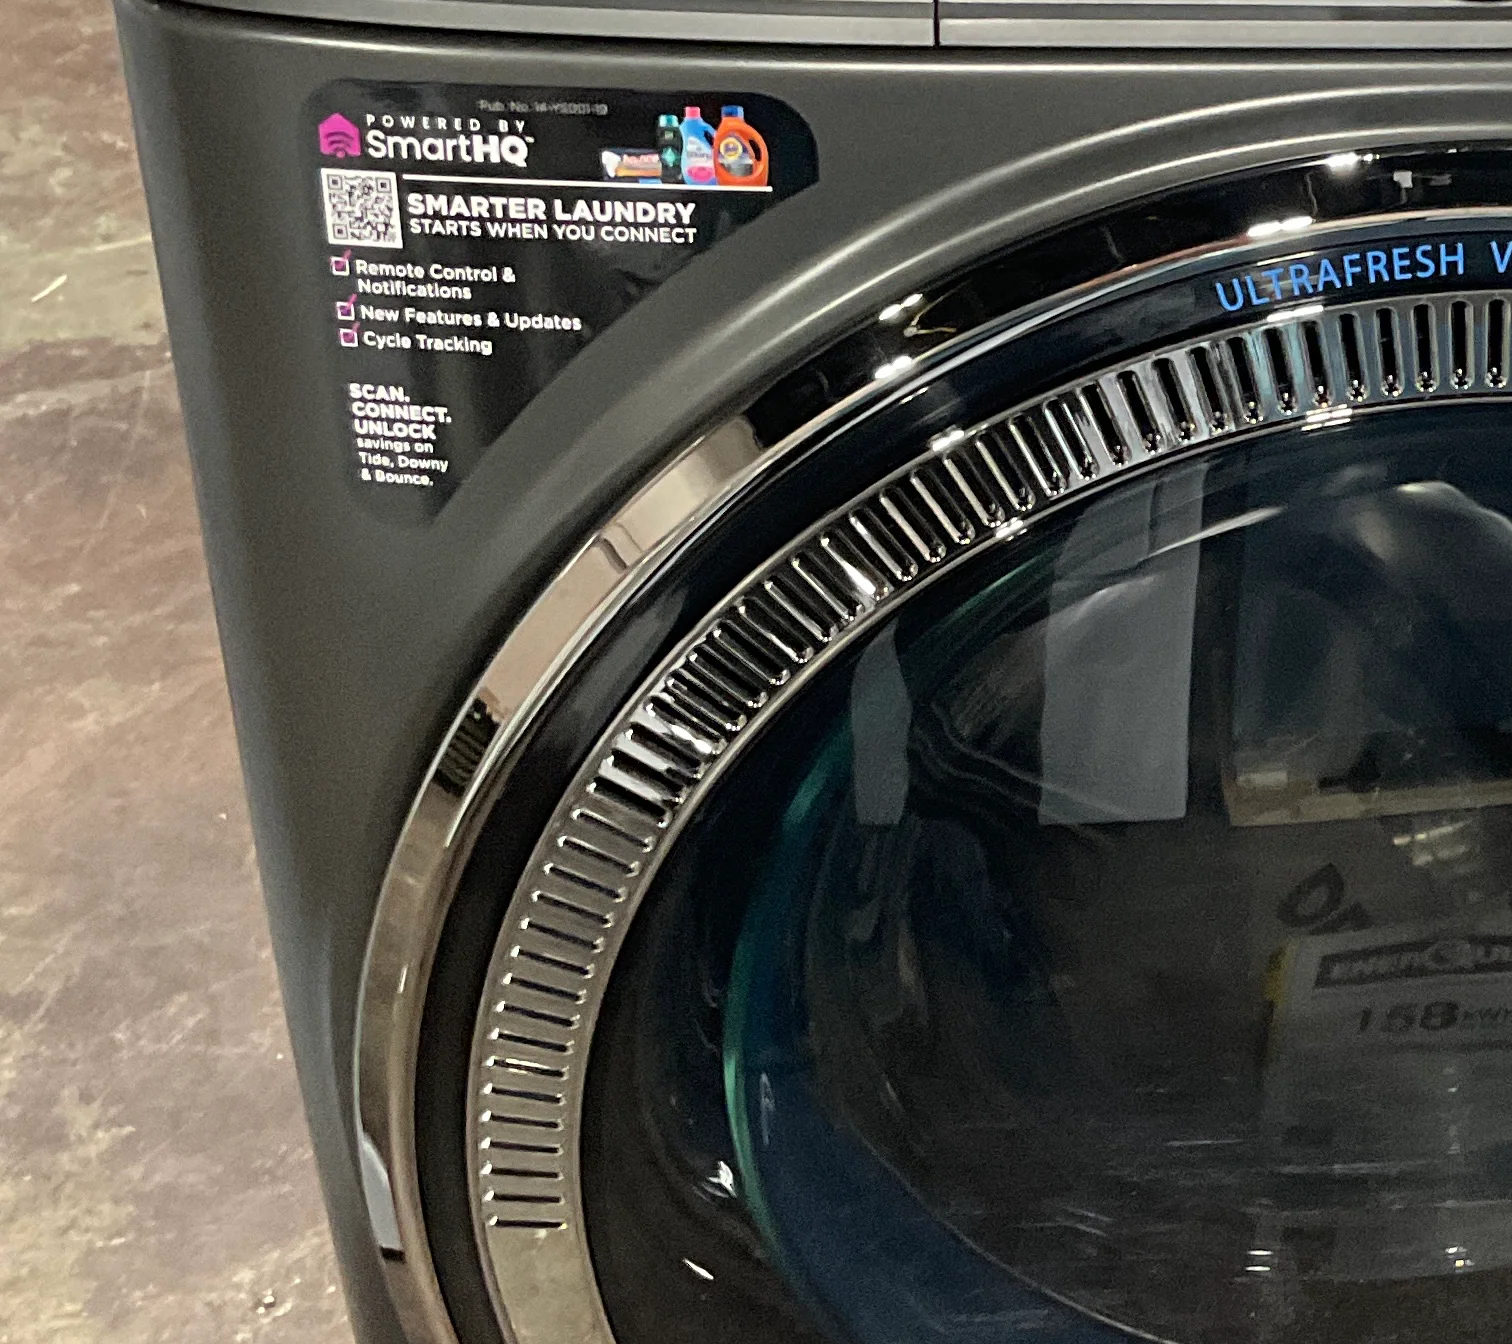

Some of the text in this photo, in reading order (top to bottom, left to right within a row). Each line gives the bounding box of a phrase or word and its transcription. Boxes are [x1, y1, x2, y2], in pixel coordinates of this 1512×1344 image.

[365, 113, 526, 133] POWERED BY
[365, 129, 529, 167] SmartHQ
[407, 192, 697, 225] SMARTER LAUNDRY
[409, 218, 698, 244] STARTS WHEN YOU CONNECT
[355, 259, 517, 283] Remote Control &
[1214, 242, 1466, 312] ULTRAFRESH
[357, 278, 473, 300] Notifications
[360, 304, 583, 332] New Features & Updates
[363, 330, 493, 356] Cycle Tracking
[349, 382, 411, 403] SCAN.
[351, 401, 453, 424] CONNECT.
[353, 418, 437, 441] UNLOCK
[356, 437, 434, 454] savings on
[397, 455, 449, 473] Downy
